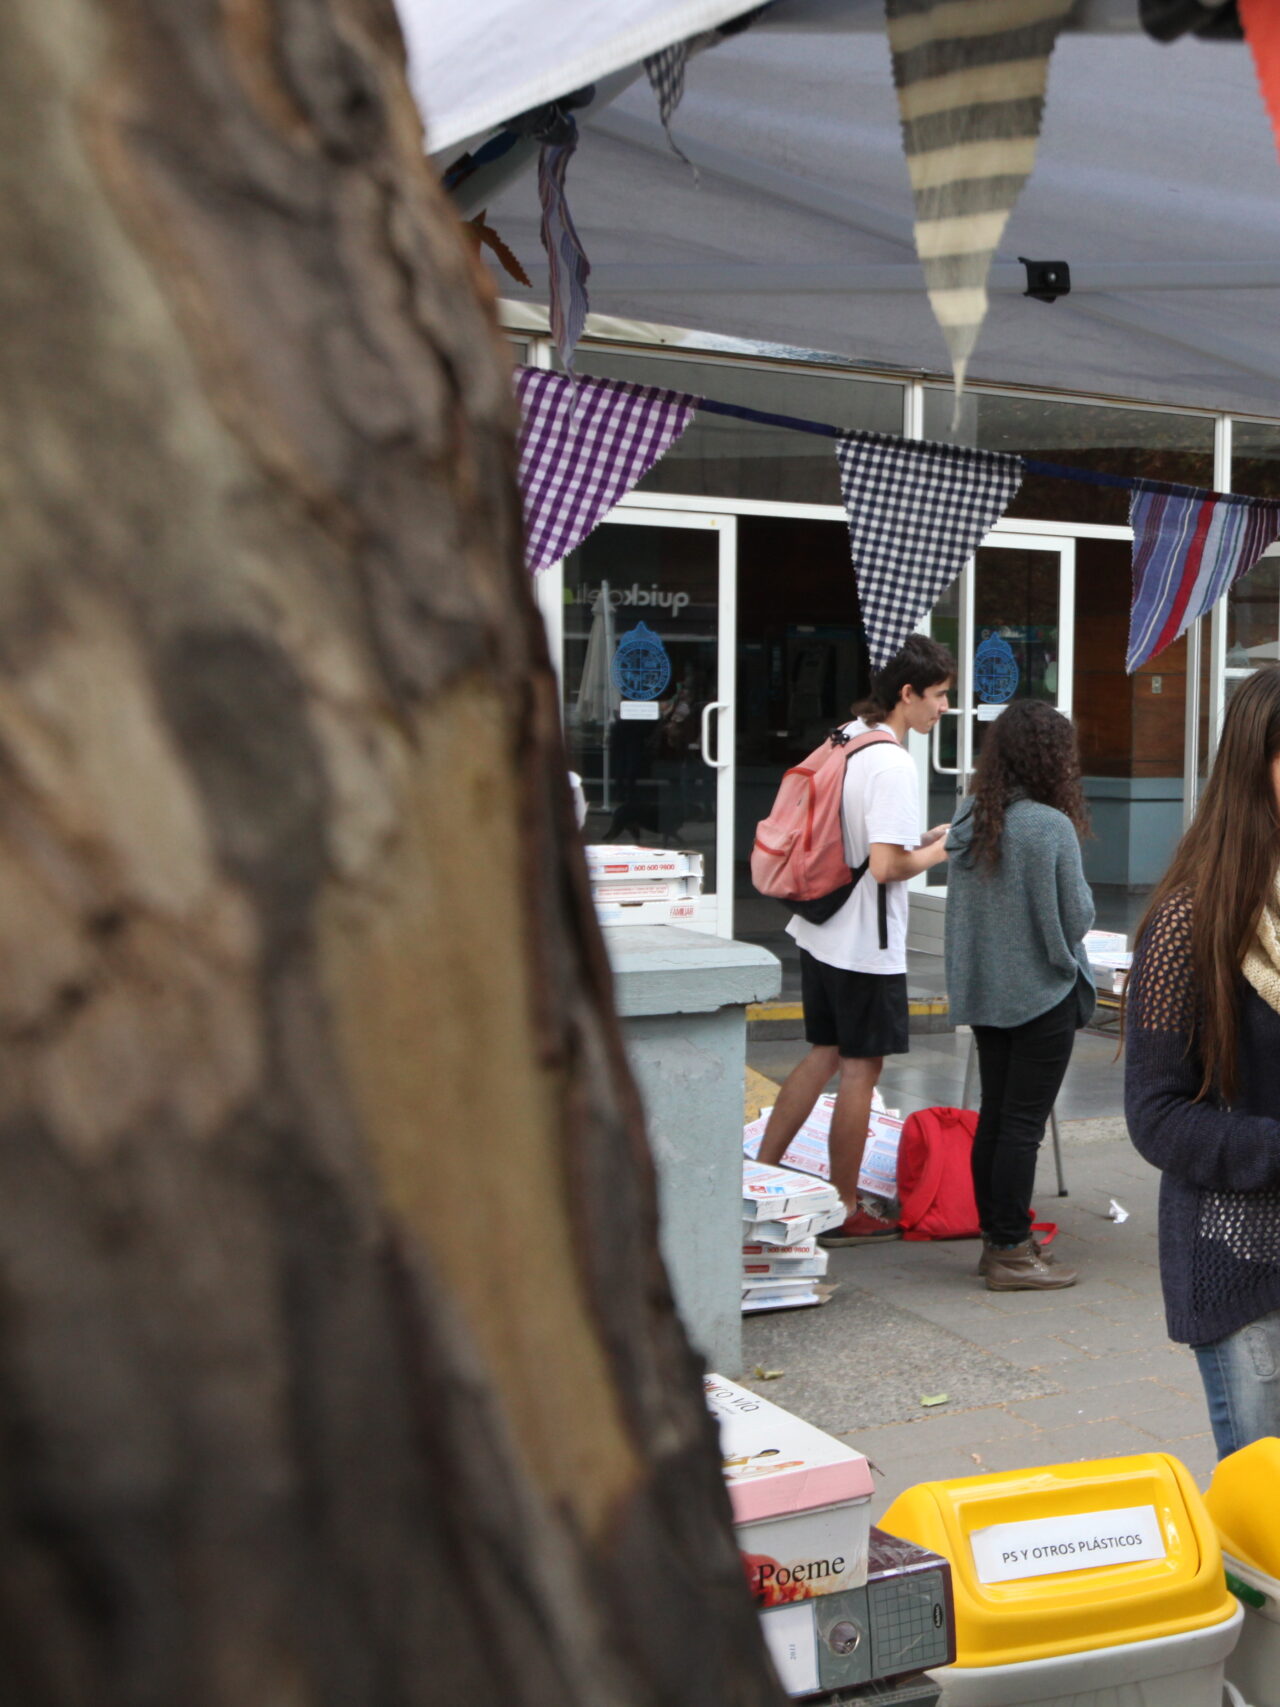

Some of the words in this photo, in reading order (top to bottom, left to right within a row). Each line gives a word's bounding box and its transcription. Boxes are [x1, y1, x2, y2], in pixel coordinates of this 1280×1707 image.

[1002, 1551, 1018, 1563] PS
[1020, 1549, 1028, 1560] Y
[1032, 1542, 1076, 1559] OTROS
[1078, 1534, 1143, 1553] PLÁSTICOS
[757, 1556, 845, 1591] Poeme
